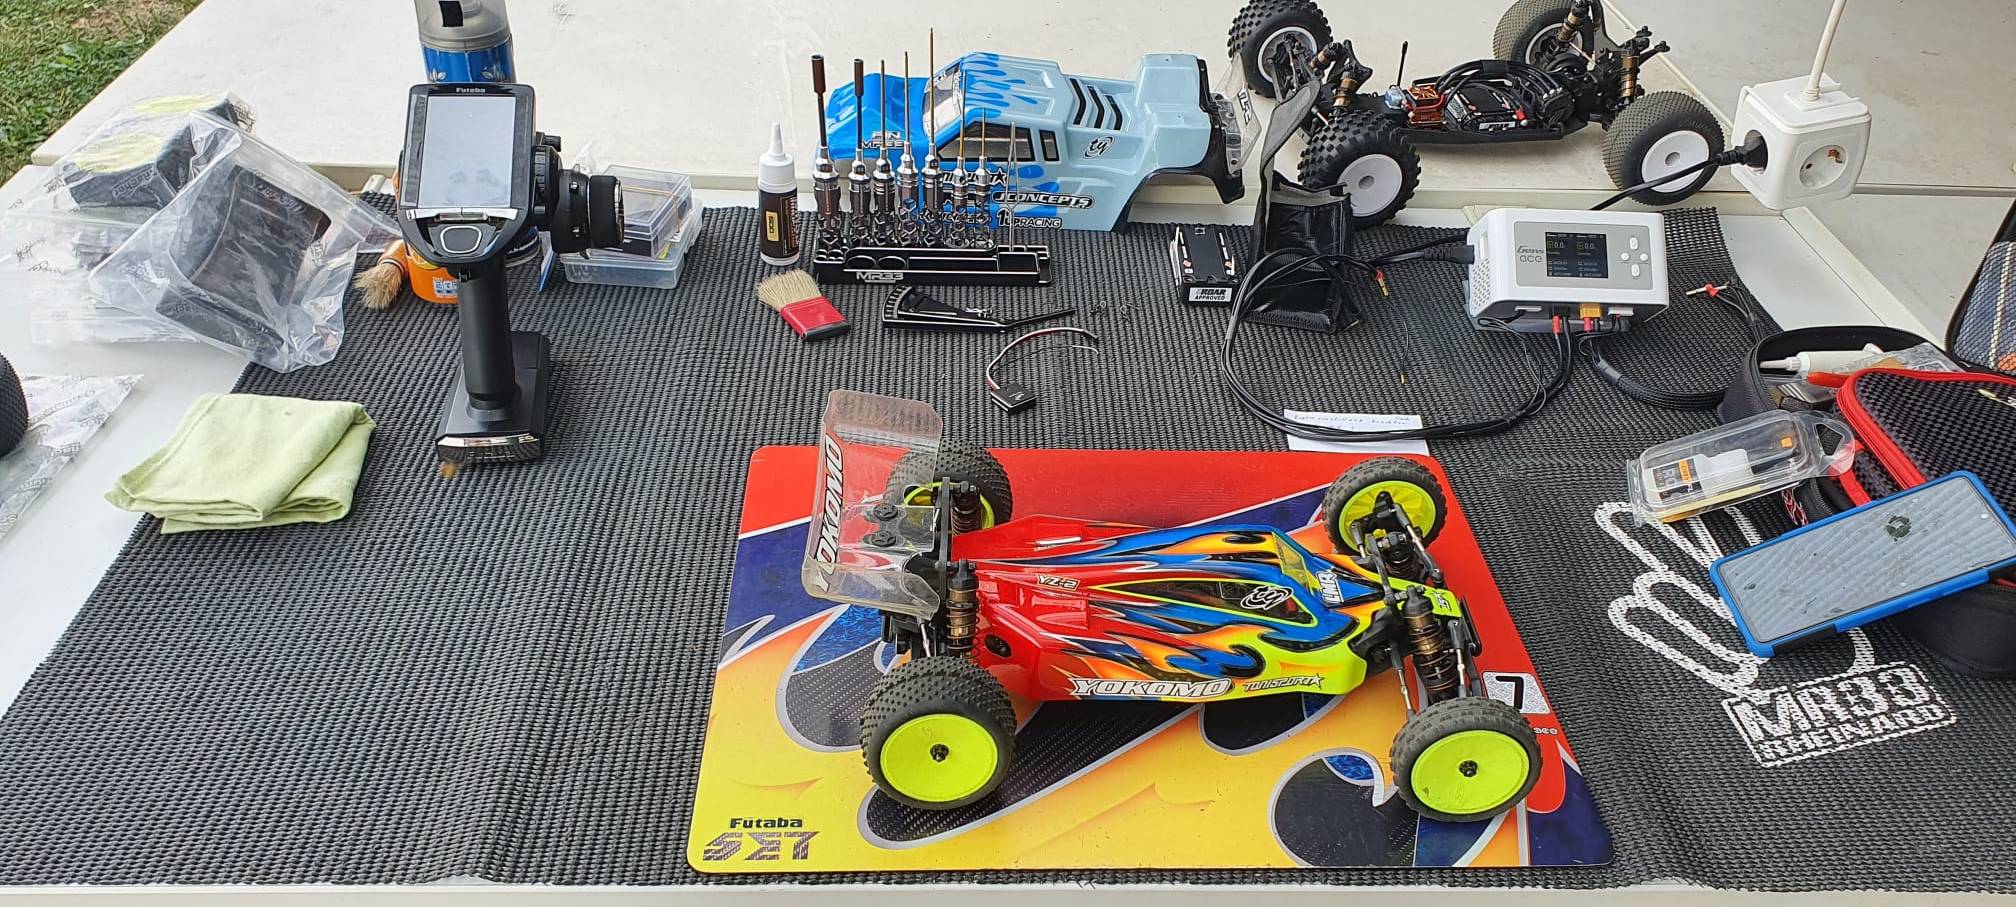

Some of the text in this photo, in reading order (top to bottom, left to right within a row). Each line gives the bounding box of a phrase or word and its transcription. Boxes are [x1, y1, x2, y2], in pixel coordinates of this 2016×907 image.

[994, 192, 1091, 209] JCONCEPTS
[856, 272, 904, 280] MR33
[815, 433, 844, 593] YOKOMO
[1039, 575, 1078, 588] YZ-2
[1071, 677, 1234, 699] YOKOMO
[1732, 666, 1931, 742] MR33
[1758, 704, 1946, 760] RHEINARD
[729, 818, 803, 829] Futaba
